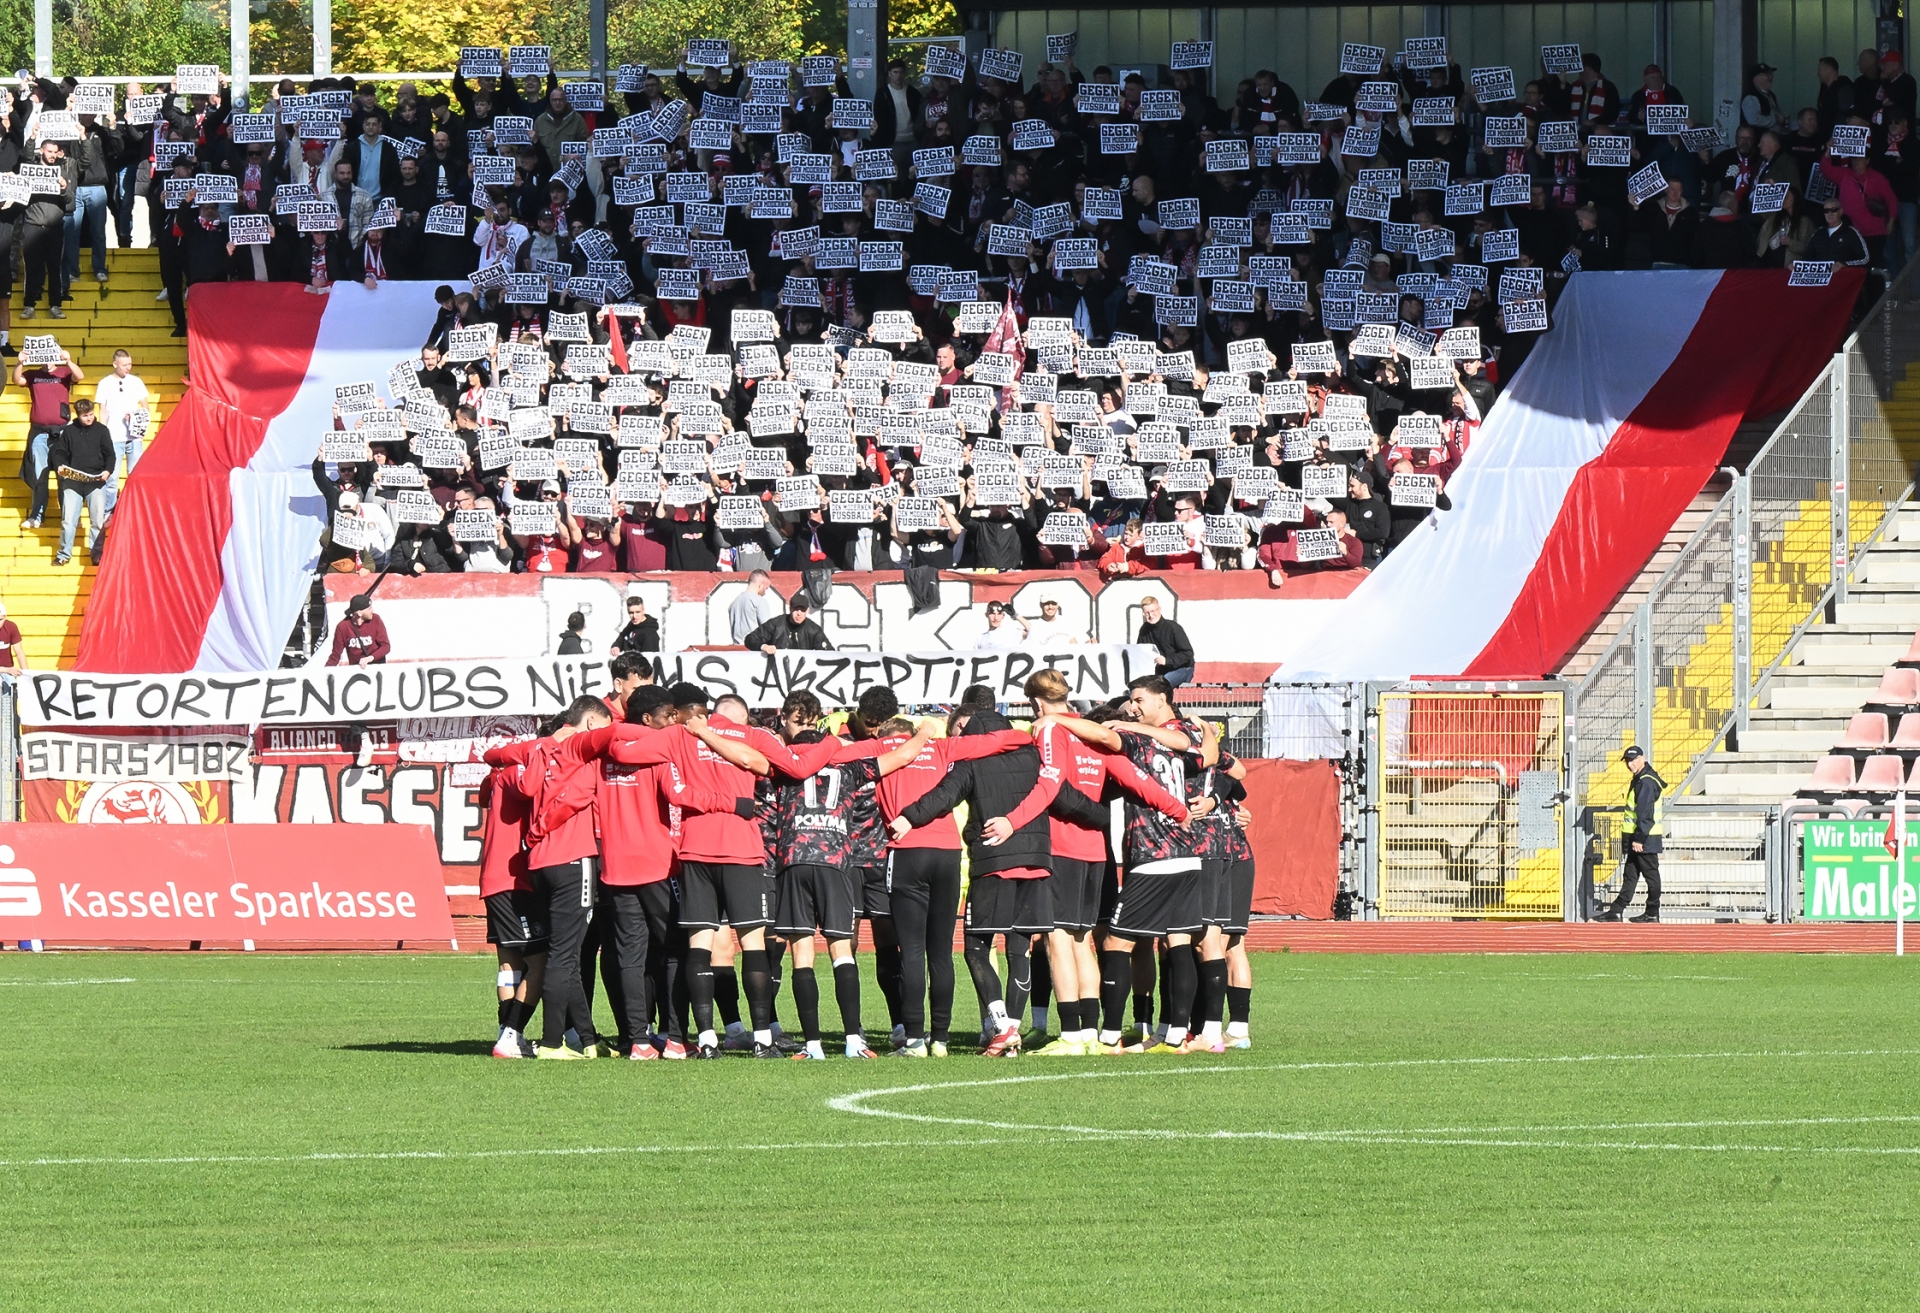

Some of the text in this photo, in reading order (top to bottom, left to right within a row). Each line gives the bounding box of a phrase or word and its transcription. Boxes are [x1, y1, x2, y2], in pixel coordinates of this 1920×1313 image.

[1174, 43, 1211, 54] GEGEN
[1407, 39, 1444, 51] GEGEN
[463, 49, 501, 60] GEGEN
[511, 48, 548, 58] GEGEN
[1344, 44, 1383, 59] GEGEN
[1173, 59, 1210, 67] FUSSBALL
[1408, 57, 1446, 67] FUSSBALL
[463, 67, 501, 75] FUSSBALL
[510, 65, 549, 73] FUSSBALL
[1342, 63, 1380, 73] FUSSBALL
[1080, 85, 1118, 97] GEGEN
[1080, 103, 1119, 112] FUSSBALL
[1416, 99, 1452, 109] GEGEN
[235, 116, 273, 126] GEGEN
[301, 111, 339, 122] GEGEN
[1487, 119, 1525, 130] GEGEN
[235, 133, 274, 141] FUSSBALL
[301, 129, 340, 137] FUSSBALL
[1487, 137, 1526, 145] FUSSBALL
[1590, 138, 1629, 149] GEGEN
[1208, 142, 1246, 154] GEGEN
[792, 155, 830, 167] GEGEN
[1209, 160, 1249, 170] FUSSBALL
[1589, 156, 1629, 165] FUSSBALL
[669, 174, 707, 185] GEGEN
[792, 174, 830, 182] FUSSBALL
[824, 184, 860, 194] GEGEN
[669, 192, 708, 200] FUSSBALL
[825, 202, 862, 210] FUSSBALL
[231, 217, 269, 228] GEGEN
[232, 234, 270, 243] FUSSBALL
[1484, 231, 1517, 245] GEGEN
[862, 244, 901, 254] GEGEN
[1057, 241, 1096, 251] GEGEN
[1484, 250, 1518, 259] FUSSBALL
[862, 261, 901, 269] FUSSBALL
[1057, 258, 1097, 267] FUSSBALL
[1794, 263, 1834, 273] GEGEN
[660, 270, 698, 282] GEGEN
[660, 288, 698, 298] FUSSBALL
[1294, 345, 1333, 356] GEGEN
[1296, 362, 1336, 370] FUSSBALL
[336, 383, 375, 399] GEGEN
[340, 401, 377, 414] FUSSBALL
[882, 416, 921, 428] GEGEN
[325, 433, 365, 443] GEGEN
[883, 436, 920, 444] FUSSBALL
[665, 444, 704, 454] GEGEN
[326, 452, 366, 460] FUSSBALL
[745, 450, 785, 461] GEGEN
[666, 463, 705, 471] FUSSBALL
[747, 469, 785, 477] FUSSBALL
[1395, 476, 1436, 488] GEGEN
[832, 493, 872, 504] GEGEN
[1395, 495, 1435, 505] FUSSBALL
[721, 499, 761, 510] GEGEN
[899, 499, 937, 511] GEGEN
[833, 512, 872, 520] FUSSBALL
[723, 517, 762, 527] FUSSBALL
[899, 518, 938, 527] FUSSBALL
[1145, 525, 1185, 537] GEGEN
[1147, 543, 1186, 553] FUSSBALL
[32, 667, 509, 720] RETORTENCLUBS
[804, 767, 841, 809] 17
[1811, 824, 1918, 848] Wir brinn
[1811, 865, 1920, 917] Male
[59, 881, 417, 926] Kasseler Sparkasse
